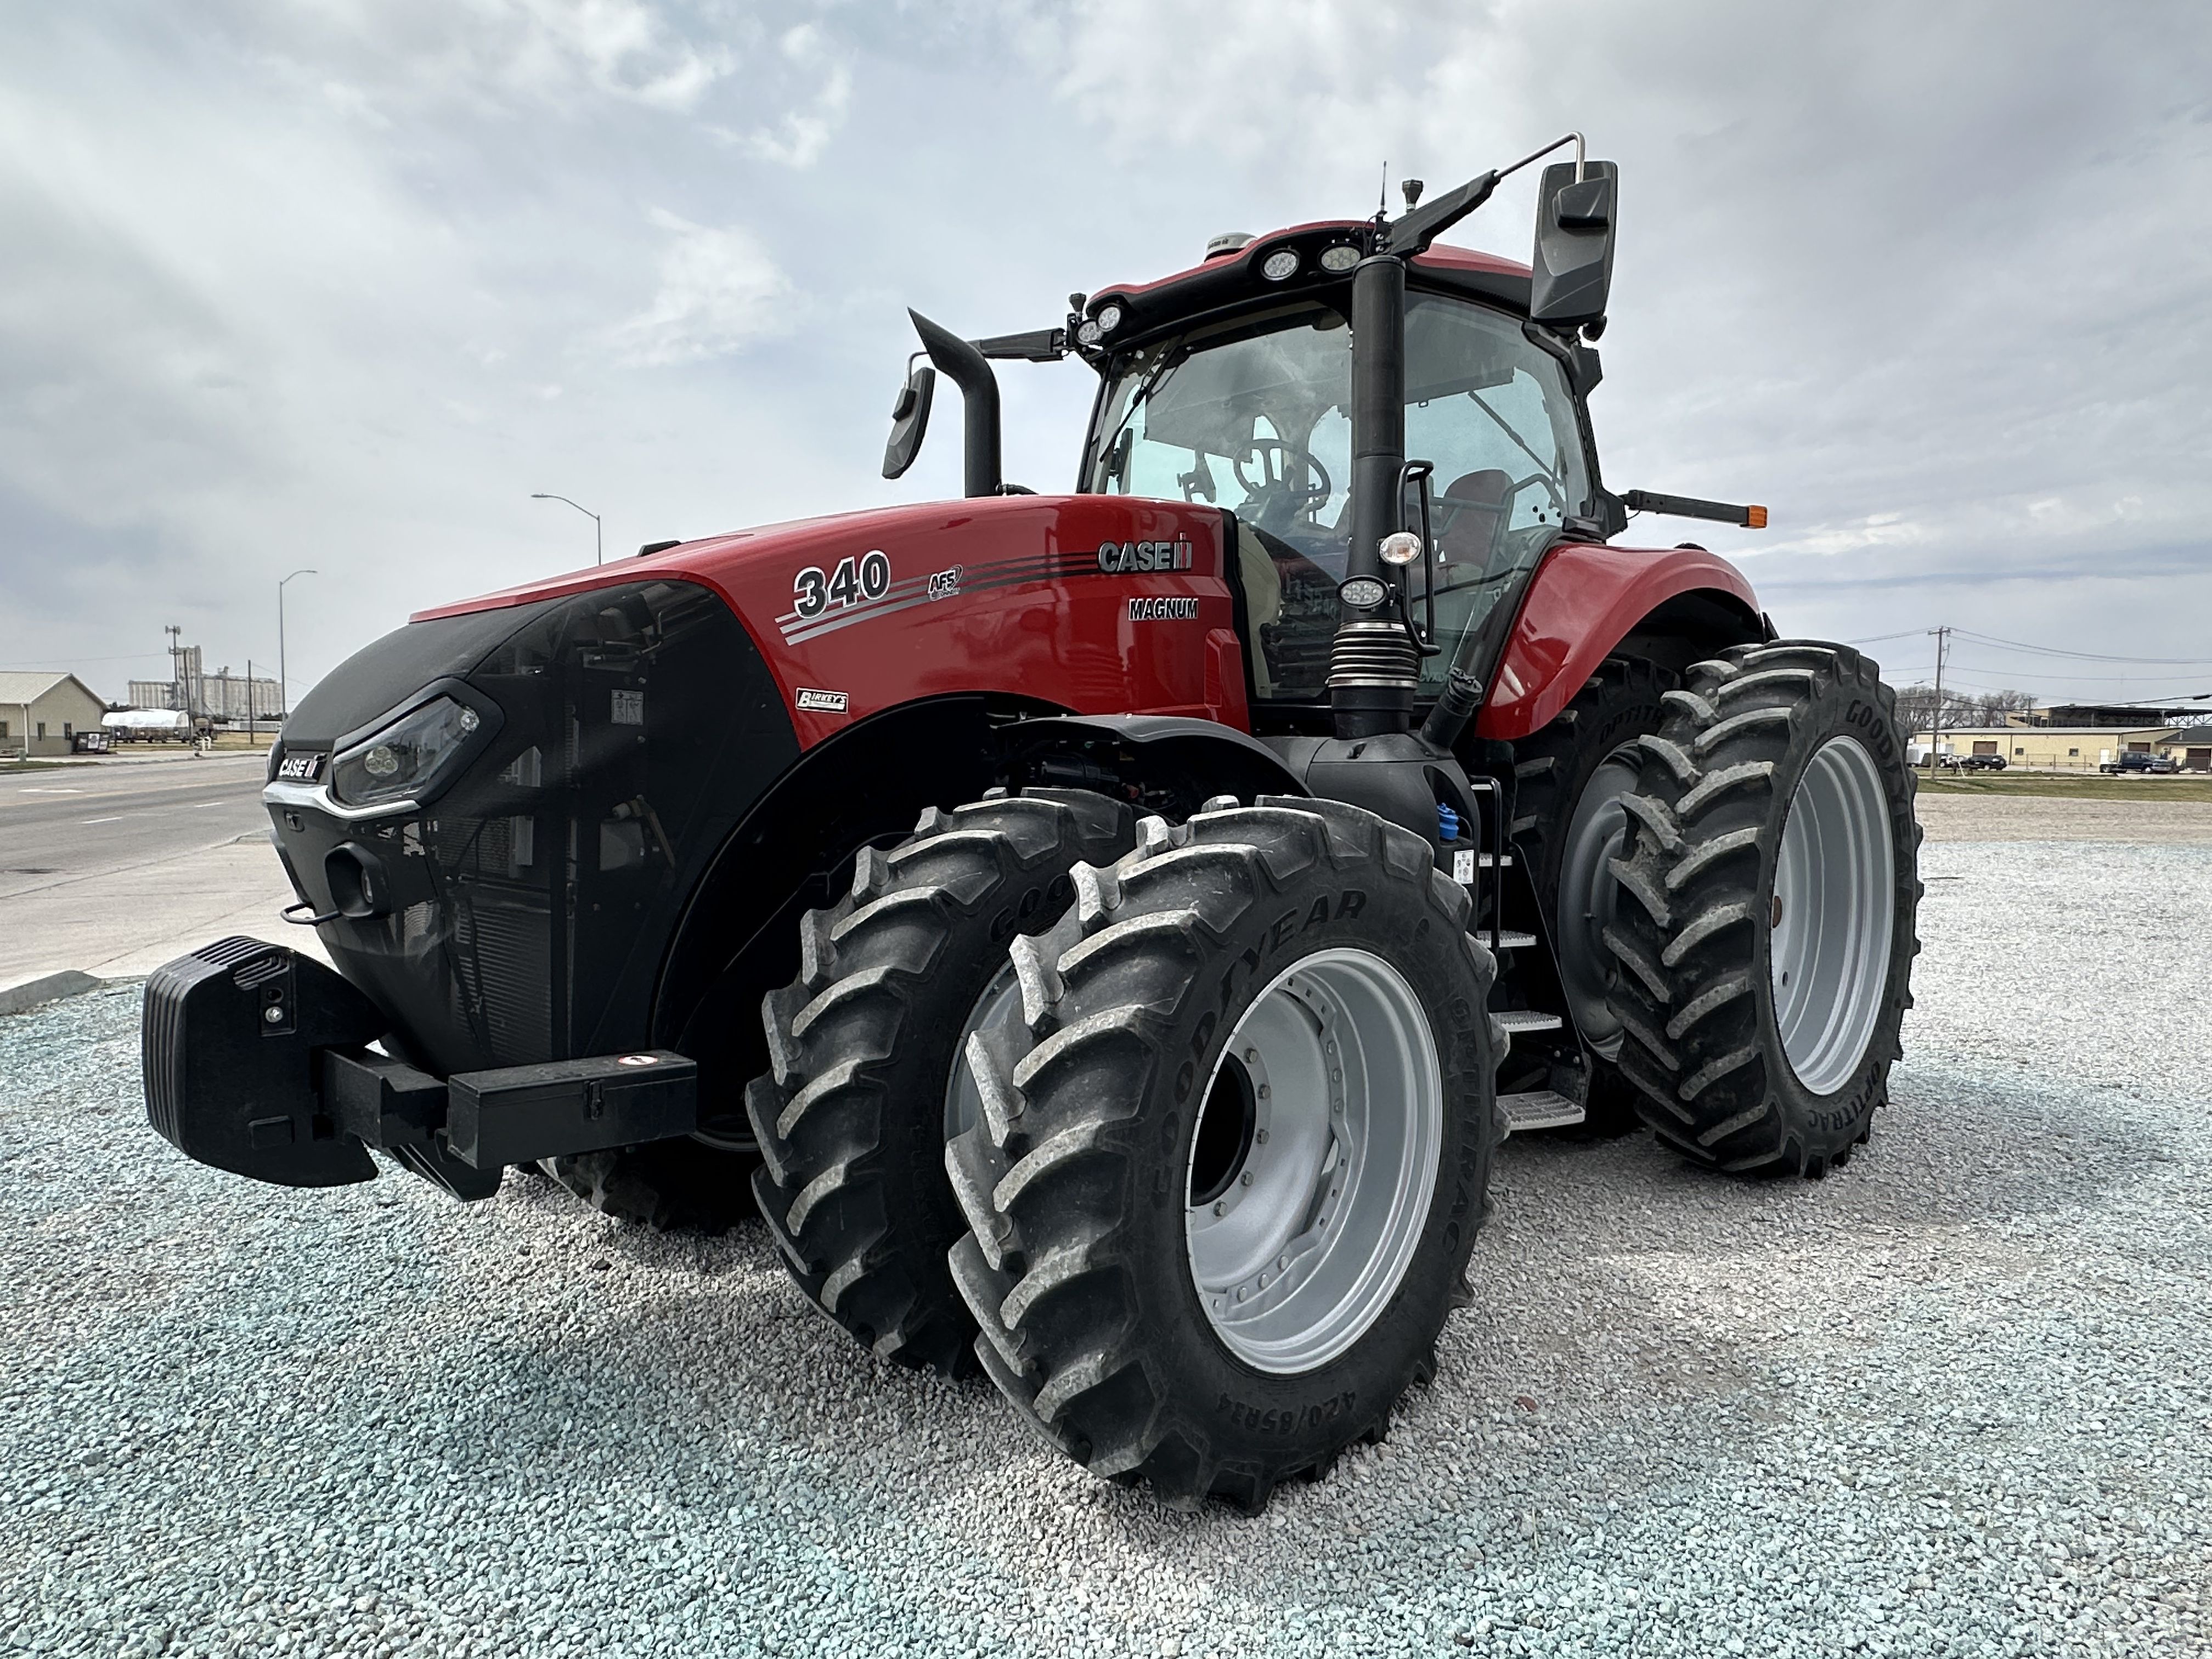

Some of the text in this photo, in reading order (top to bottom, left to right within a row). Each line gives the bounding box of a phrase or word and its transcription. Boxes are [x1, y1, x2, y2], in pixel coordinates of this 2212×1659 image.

[1099, 541, 1170, 572] CASE
[794, 550, 891, 619] 340
[928, 570, 956, 593] AFS
[1128, 597, 1199, 620] MAGNUM
[279, 758, 308, 777] CASE
[989, 873, 1070, 943] GOO
[1808, 1060, 1881, 1132] OPTITRAC
